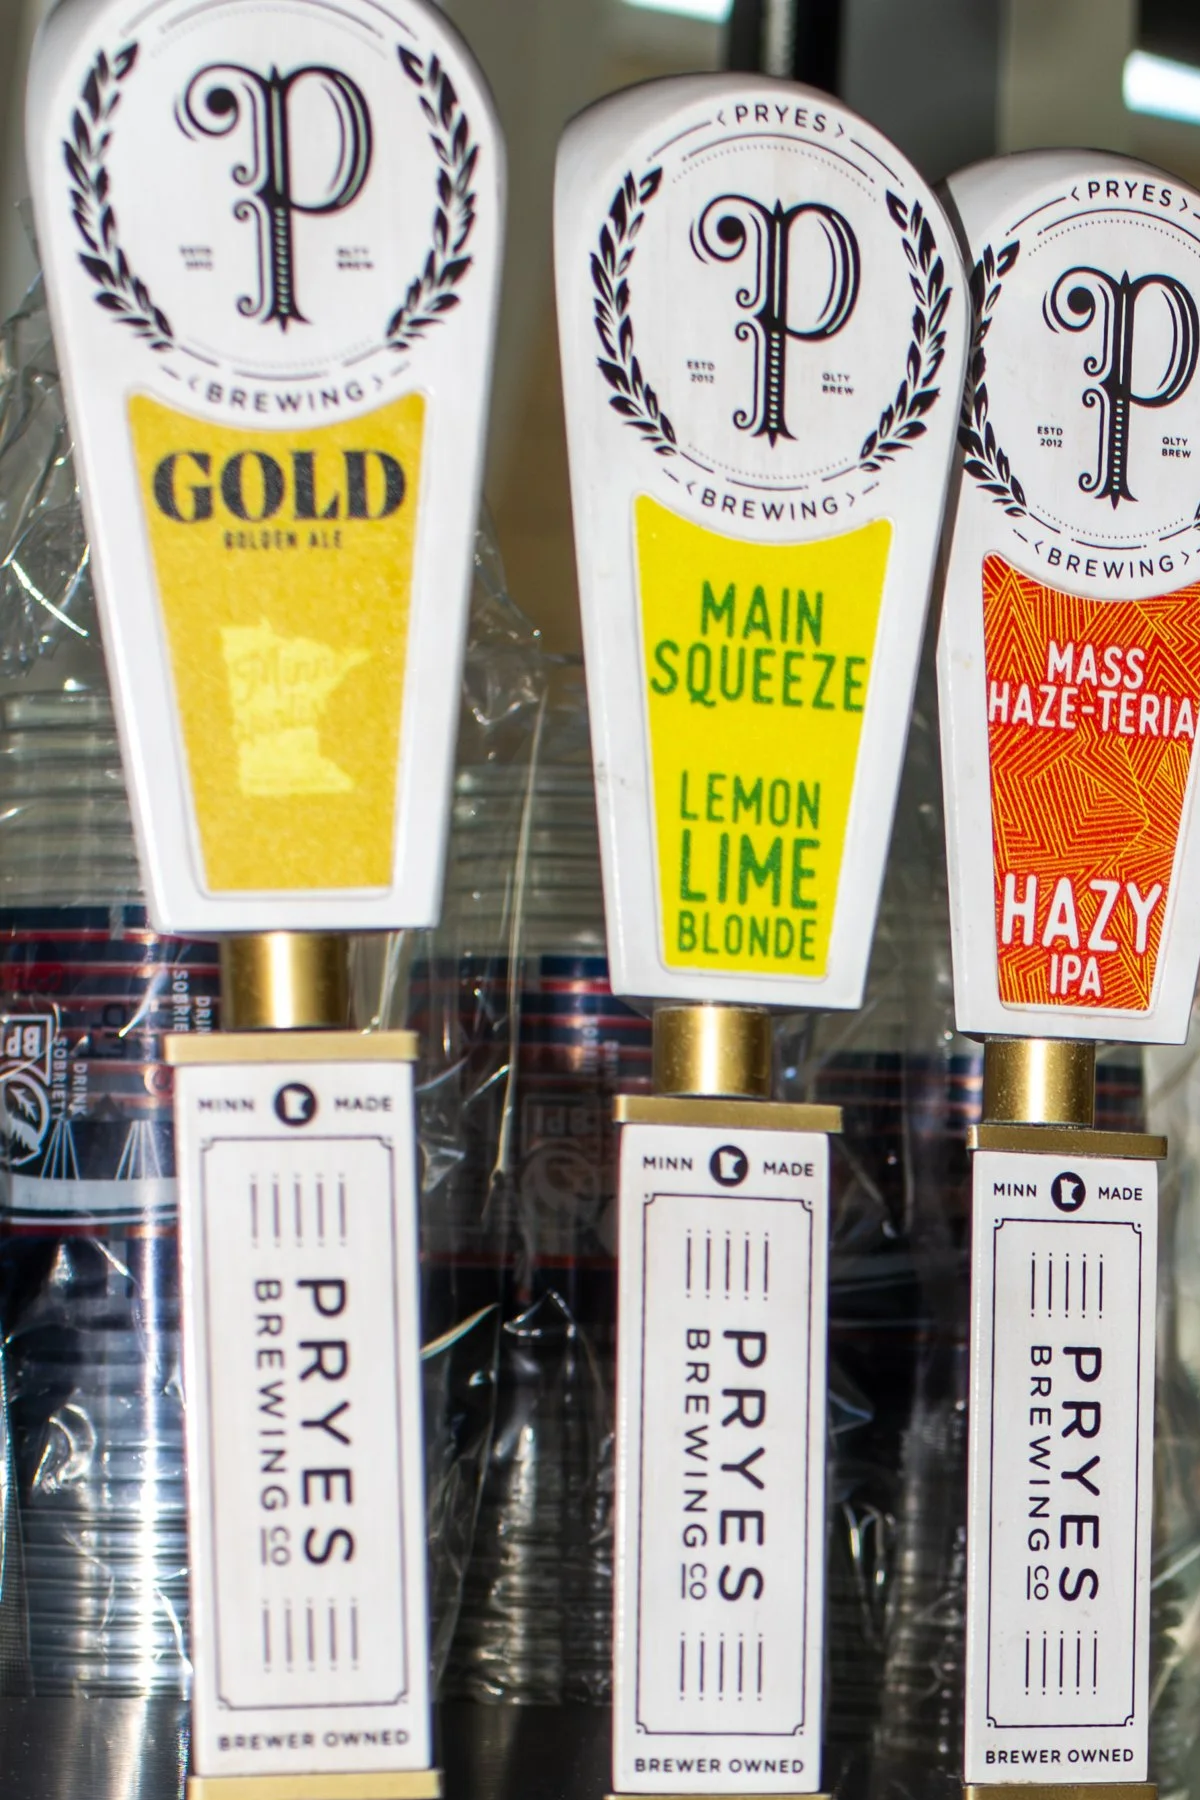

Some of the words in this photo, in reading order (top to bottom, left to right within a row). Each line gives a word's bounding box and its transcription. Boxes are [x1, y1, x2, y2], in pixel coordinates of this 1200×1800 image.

[735, 103, 827, 133] PRYES
[1087, 180, 1173, 208] PRYES
[206, 382, 365, 414] BREWING
[821, 384, 855, 396] BREW
[1037, 425, 1064, 436] ESTD
[1040, 438, 1063, 449] 2012
[1162, 436, 1189, 448] QLTY
[1161, 448, 1192, 459] BREW
[152, 449, 407, 524] GOLD
[700, 488, 839, 521] BREWING
[223, 530, 298, 550] GOLDEN
[308, 530, 343, 550] ALE
[1046, 549, 1175, 580] BREWING
[700, 580, 824, 647] MAIN
[650, 639, 867, 713] SQUEEZE
[1046, 640, 1146, 690] MASS
[987, 680, 1195, 740] HAZE-TERIA
[679, 769, 821, 830] LEMON
[679, 828, 821, 910] LIME
[1000, 872, 1163, 954] HAZY
[677, 909, 818, 961] BLONDE
[1049, 953, 1101, 998] IPA
[72, 1062, 88, 1116] DRINK
[197, 1098, 255, 1113] MINN
[333, 1096, 393, 1113] MADE
[642, 1155, 694, 1172] MINN
[762, 1161, 815, 1178] MADE
[992, 1182, 1038, 1198] MINN
[1097, 1186, 1144, 1202] MADE
[254, 1278, 290, 1512] BREWING
[296, 1278, 355, 1566] PRYES
[682, 1328, 711, 1548] BREWING
[718, 1329, 768, 1602] PRYES
[1027, 1344, 1053, 1553] BREWING
[1058, 1345, 1103, 1602] PRYES
[268, 1525, 292, 1567] CO
[688, 1562, 708, 1601] CO
[1033, 1565, 1050, 1601] CO
[217, 1733, 315, 1751] BREWER
[323, 1729, 410, 1747] OWNED
[984, 1749, 1061, 1765] BREWER
[1067, 1748, 1135, 1764] OWNED
[634, 1758, 722, 1774] BREWER
[728, 1758, 805, 1775] OWNED
